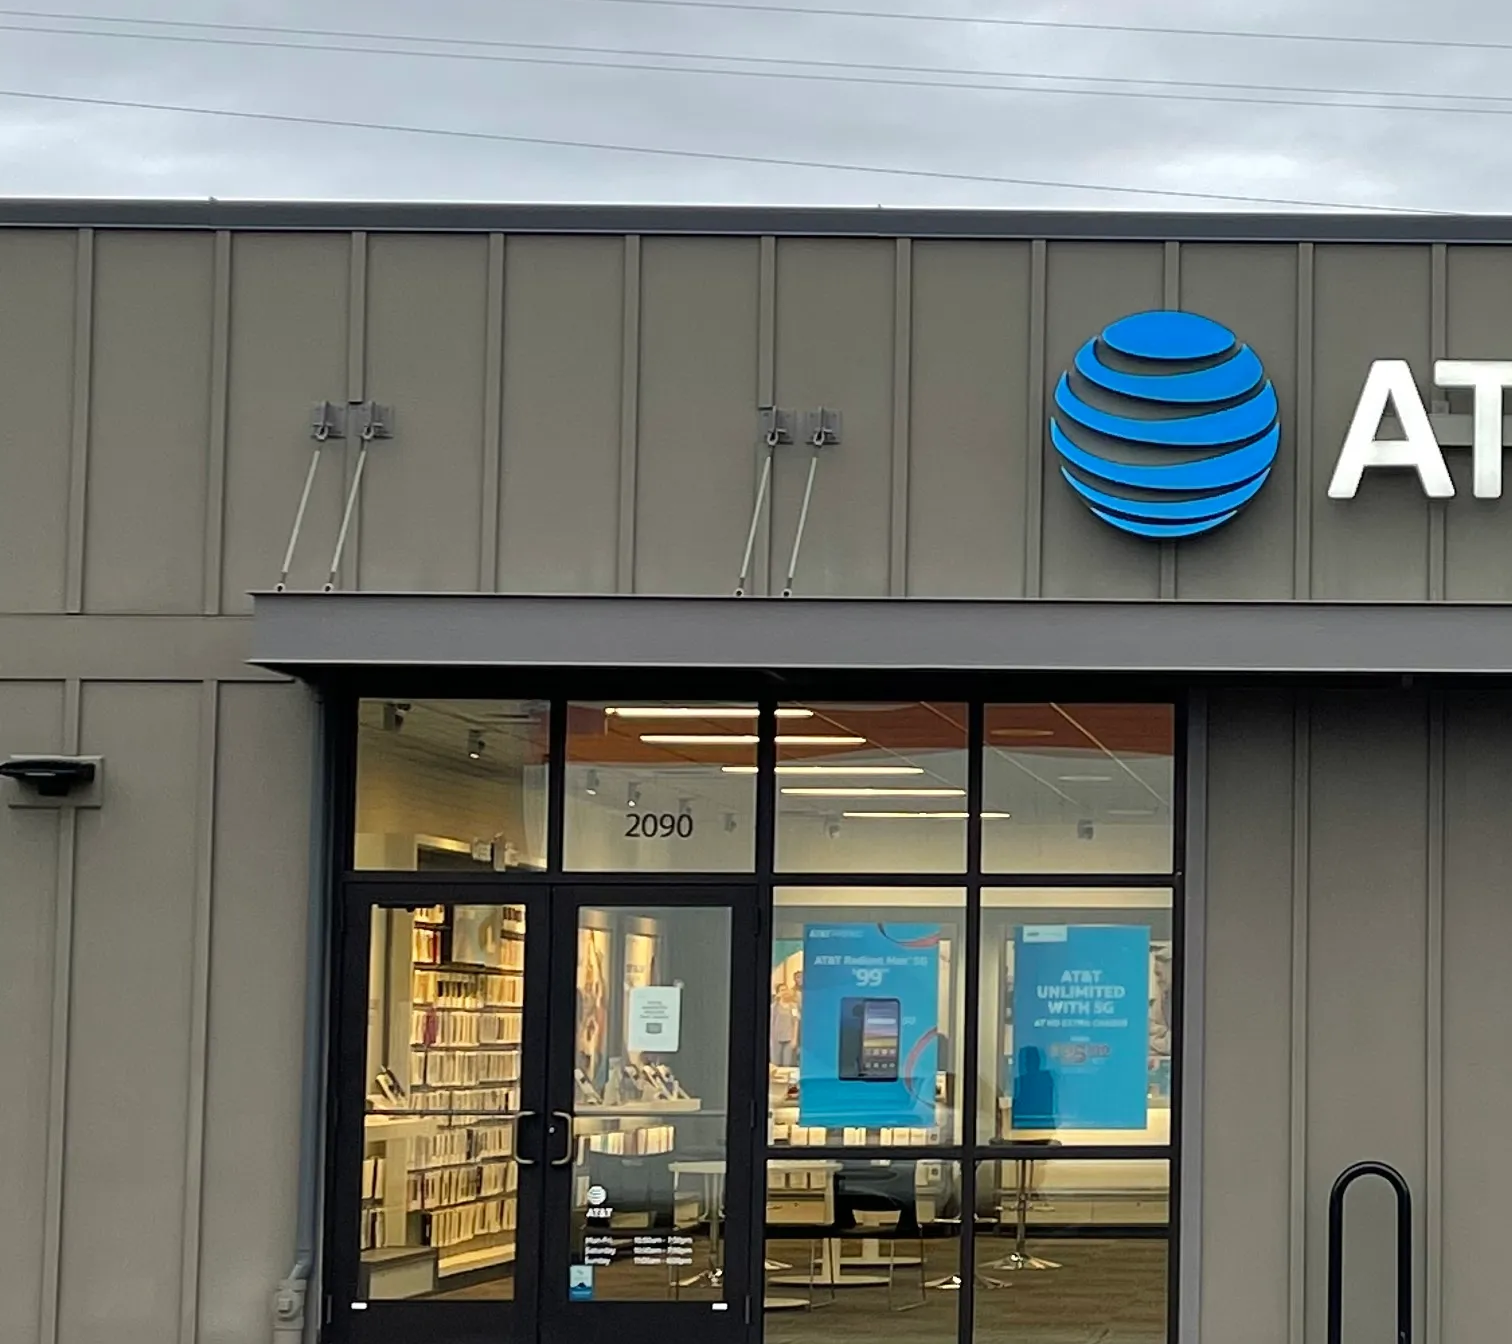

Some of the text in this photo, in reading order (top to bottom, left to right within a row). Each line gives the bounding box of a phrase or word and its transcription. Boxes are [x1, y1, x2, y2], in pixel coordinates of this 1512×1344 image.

[625, 814, 693, 837] 2090
[814, 955, 841, 965] AT&T
[1060, 970, 1103, 983] AT&T
[1036, 985, 1126, 999] UNLIMITED
[1047, 1000, 1090, 1014] WITH
[586, 1208, 614, 1218] AT&T
